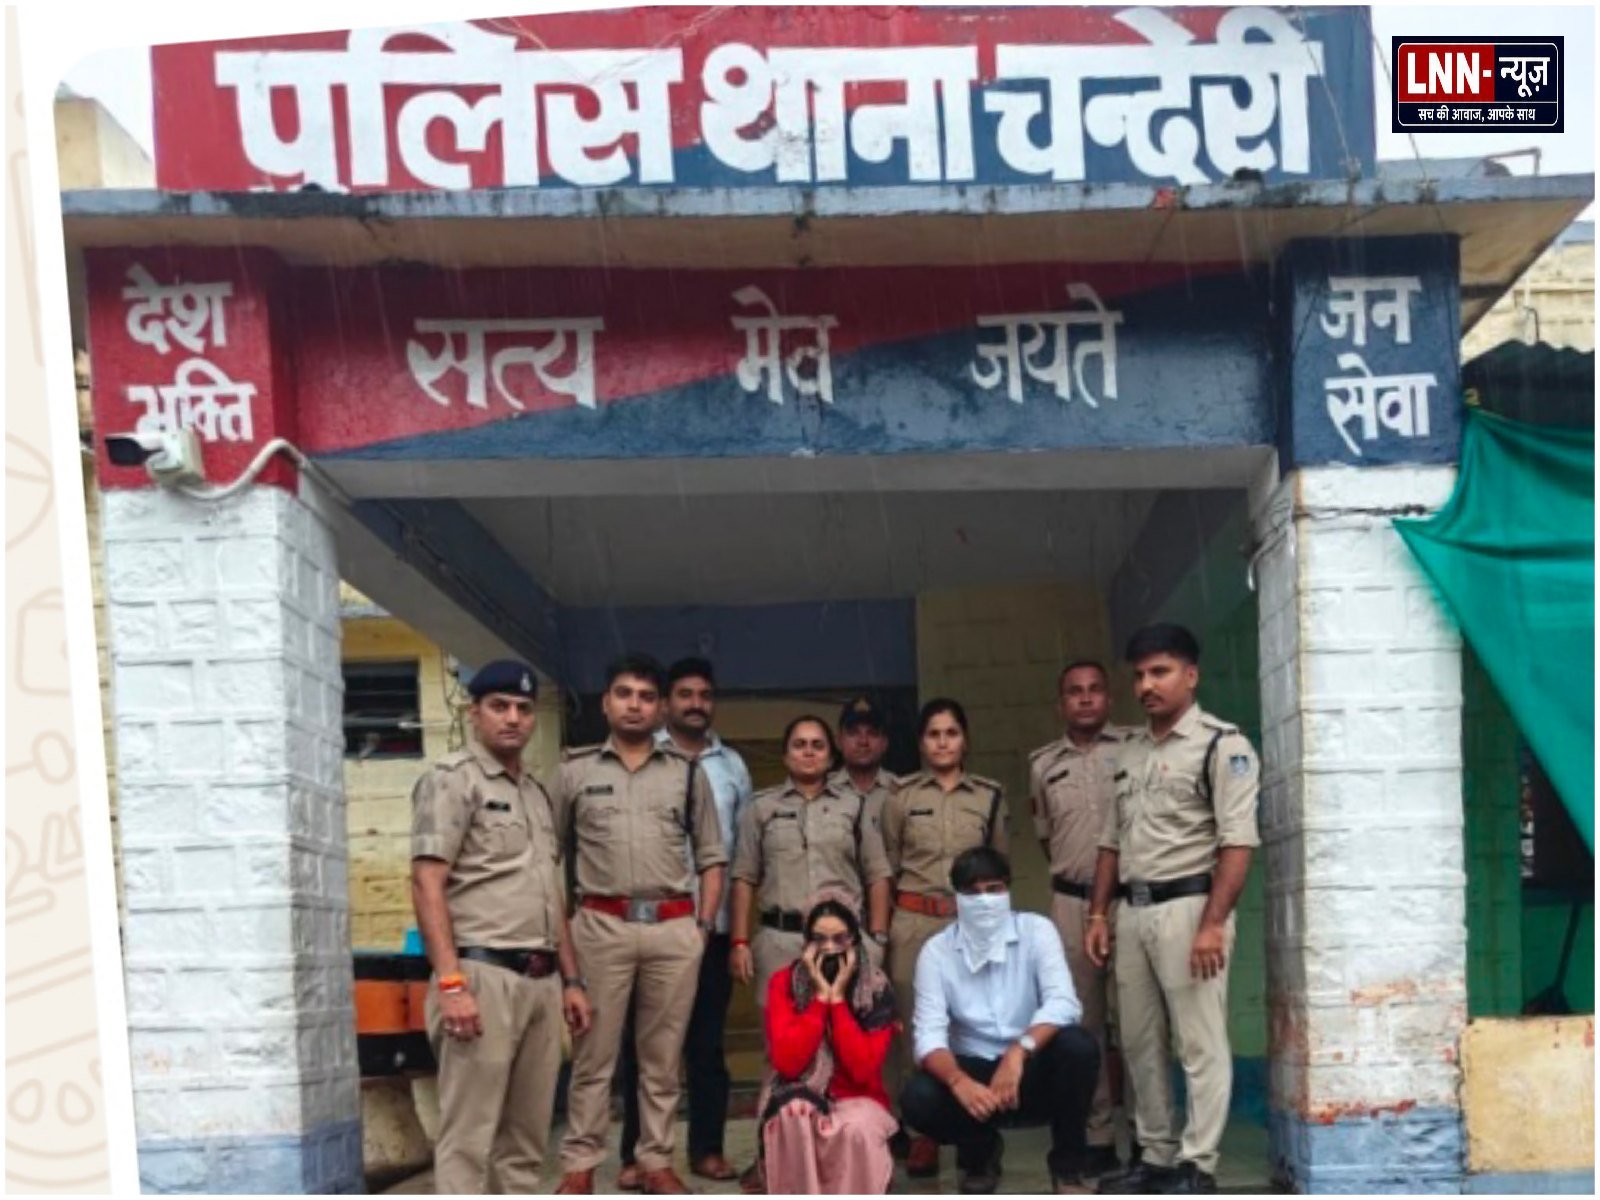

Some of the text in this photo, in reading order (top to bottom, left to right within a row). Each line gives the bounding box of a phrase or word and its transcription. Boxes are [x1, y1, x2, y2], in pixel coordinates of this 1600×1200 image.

[214, 6, 1323, 193] पलिस थाना चन्देरी
[122, 263, 232, 355] देश
[406, 283, 1123, 410] सत्य मेव जयते
[1320, 276, 1421, 346] जन
[1324, 353, 1437, 456] सेवा
